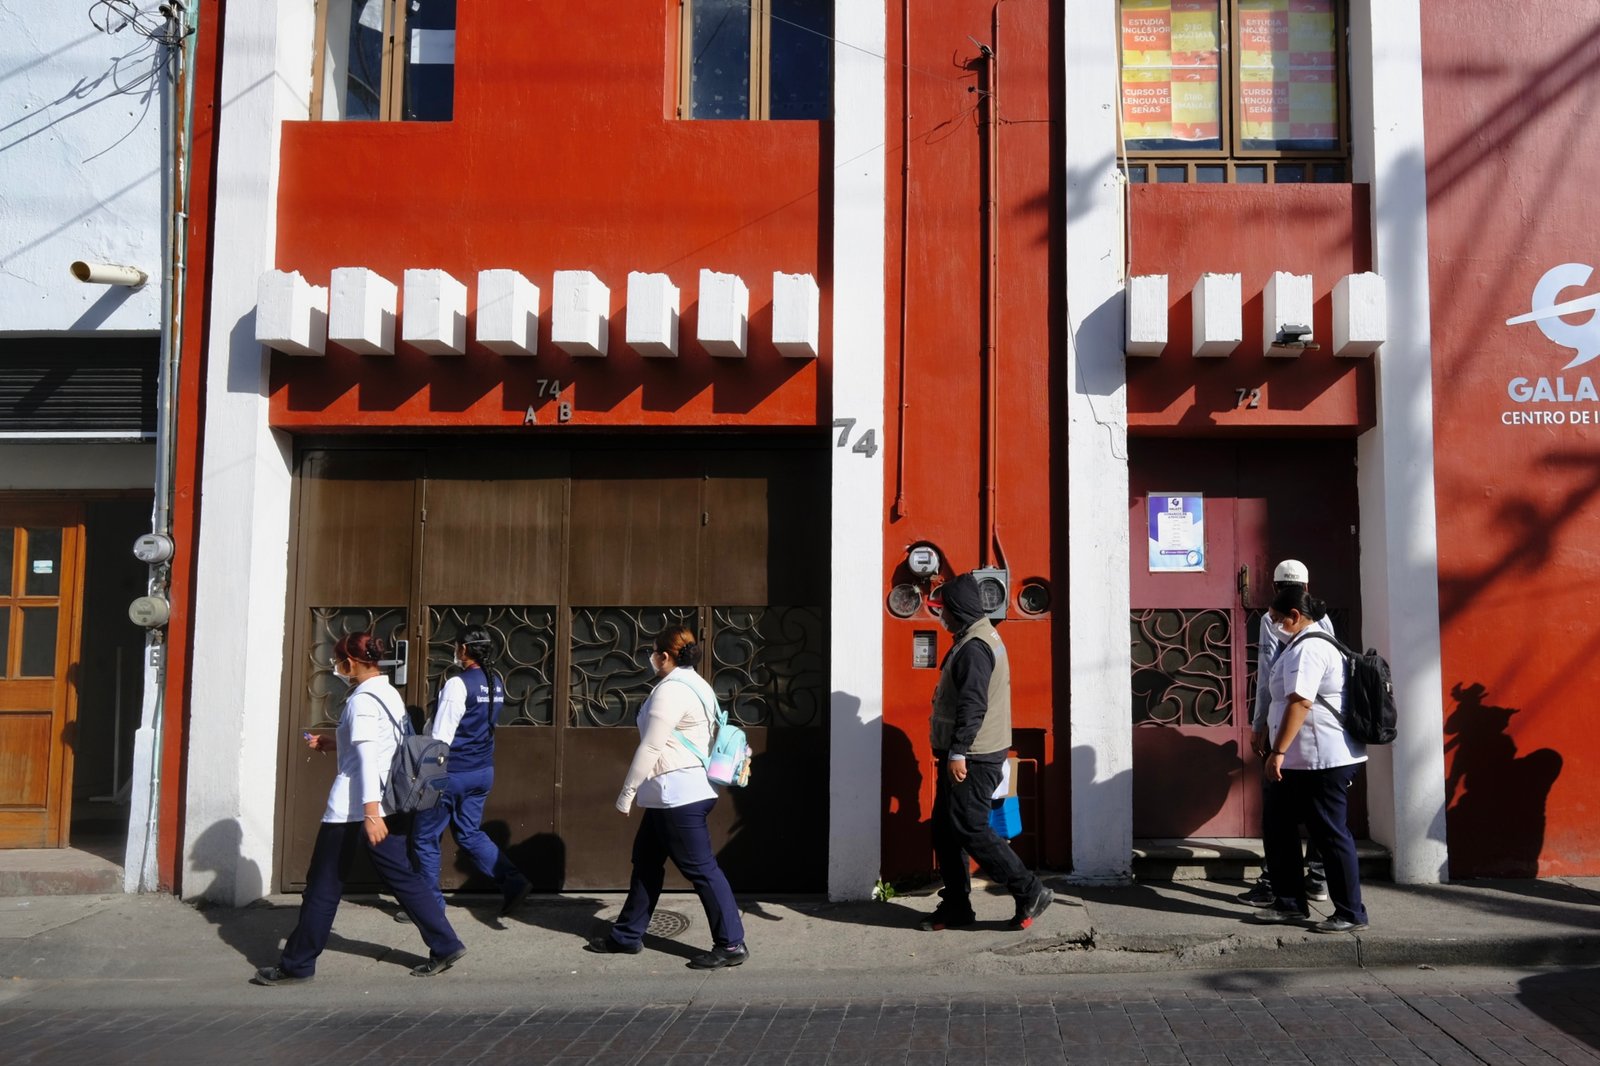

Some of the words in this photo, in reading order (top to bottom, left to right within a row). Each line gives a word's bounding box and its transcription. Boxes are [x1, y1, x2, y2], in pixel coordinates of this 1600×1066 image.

[1128, 18, 1165, 26] ESTUDIA
[1246, 18, 1282, 26] ESTUDIA
[1124, 88, 1155, 96] CURSO
[1242, 88, 1273, 96] CURSO
[1122, 97, 1158, 105] LENGUA
[1240, 97, 1276, 105] LENGUA
[1131, 104, 1161, 114] SEÑAS
[1249, 104, 1279, 114] SEÑAS
[536, 379, 561, 398] 74
[1236, 387, 1261, 407] 72
[525, 404, 537, 425] A
[560, 400, 573, 421] B
[1501, 410, 1566, 425] CENTRO
[1569, 410, 1590, 424] DE
[832, 417, 878, 458] 74
